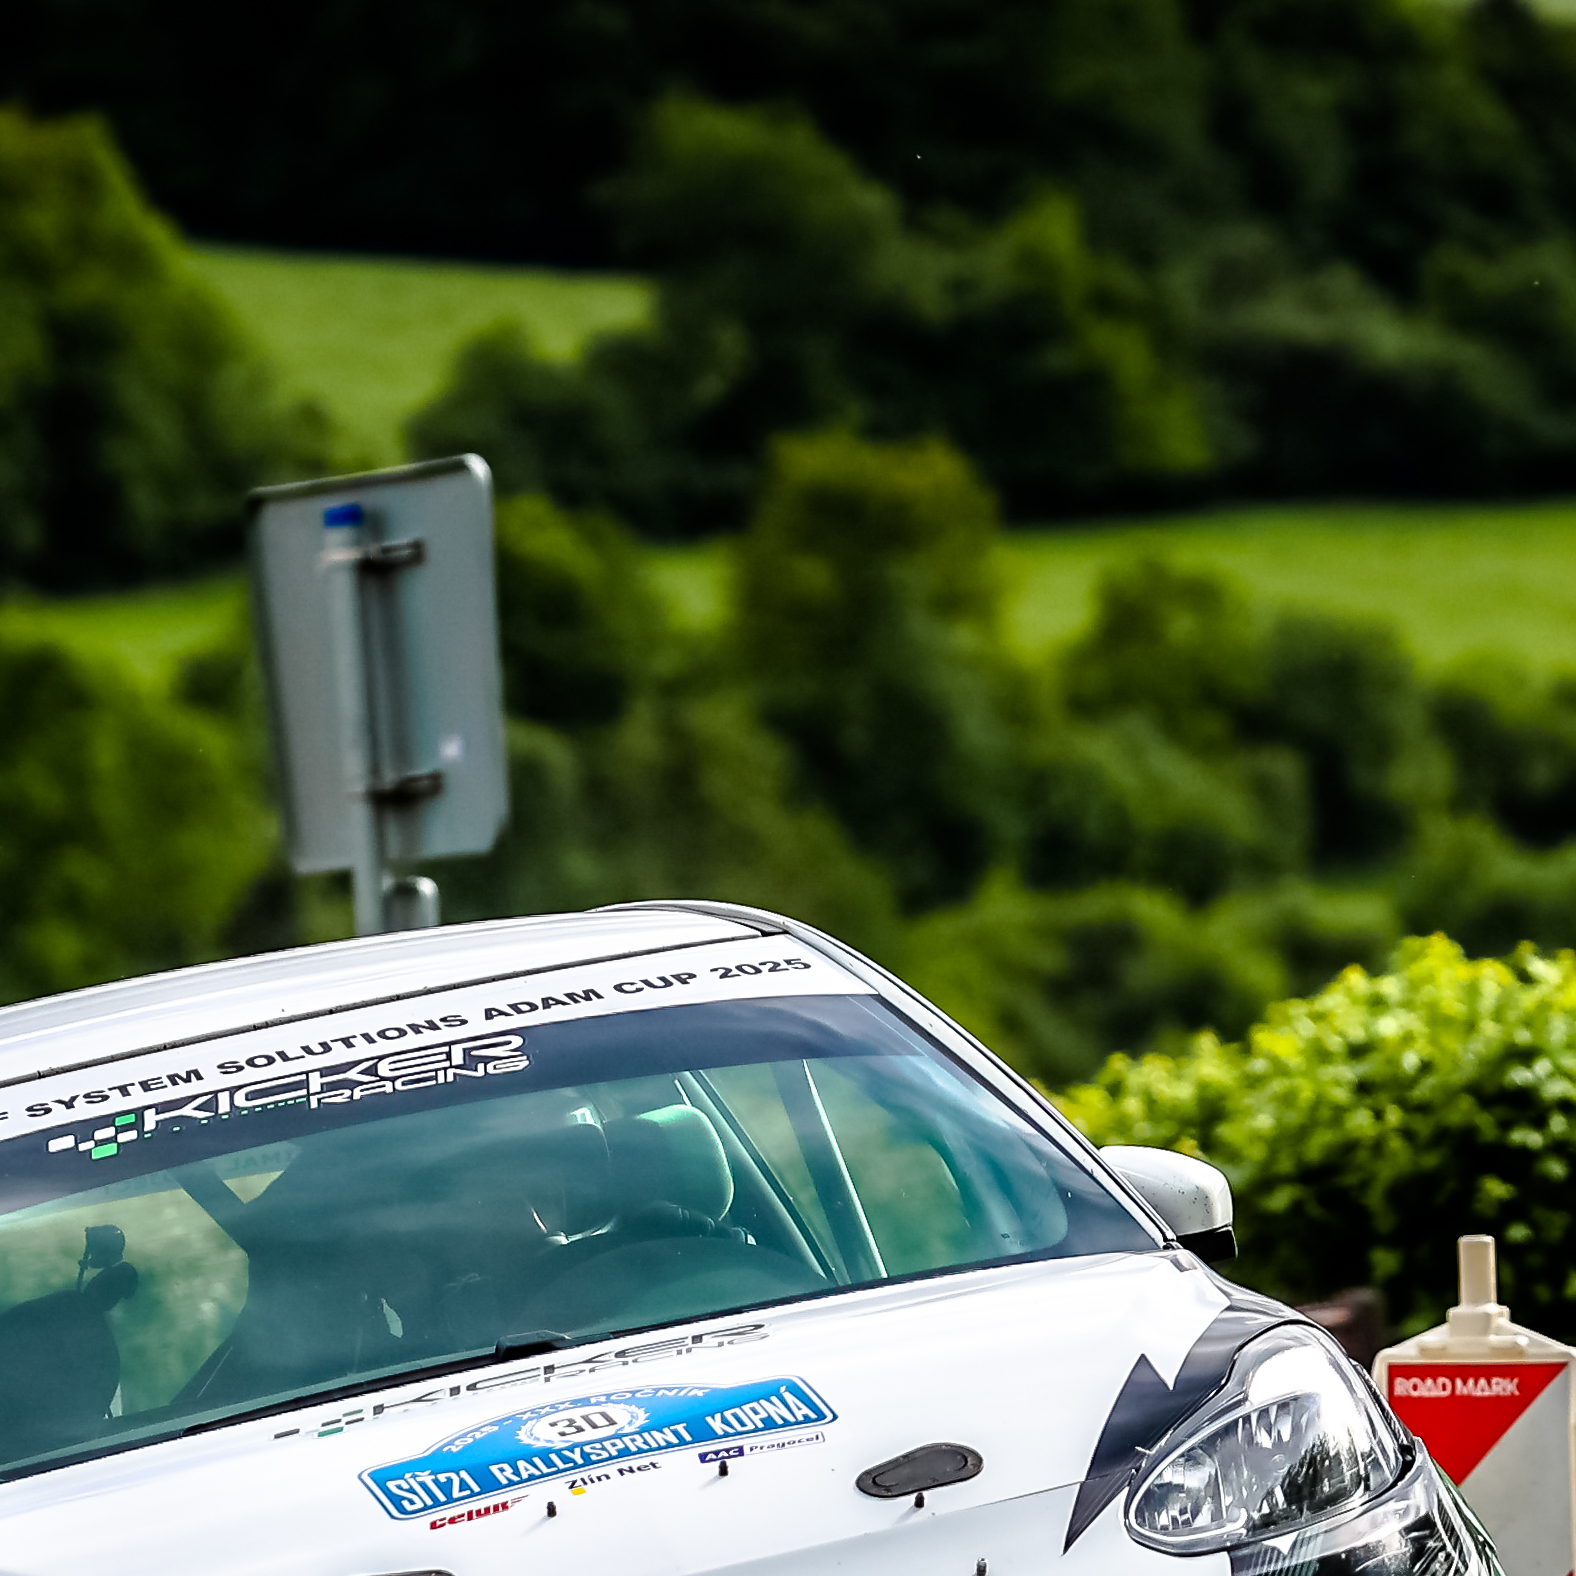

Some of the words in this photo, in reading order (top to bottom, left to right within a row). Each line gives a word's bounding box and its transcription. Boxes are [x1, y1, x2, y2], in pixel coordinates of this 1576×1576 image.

[26, 1068, 205, 1118] SYSTEM
[216, 1014, 469, 1076] SOLUTIONS
[484, 988, 605, 1021] ADAM
[612, 972, 698, 994] CUP
[709, 958, 812, 980] 2025
[142, 1033, 526, 1132] KICKER
[309, 1054, 530, 1109] RACING
[1393, 1376, 1452, 1398] ROAD
[1455, 1376, 1520, 1398] MARK
[442, 1424, 500, 1453] 2025
[589, 1386, 711, 1405] ROČNÍK
[548, 1411, 618, 1438] 30
[385, 1470, 481, 1514] SÍŤ21
[489, 1423, 695, 1485] RALLYSPRINT
[706, 1386, 817, 1437] KOPNÁ
[564, 1472, 611, 1491] Zlín
[617, 1460, 662, 1479] Net
[704, 1446, 741, 1462] AAC
